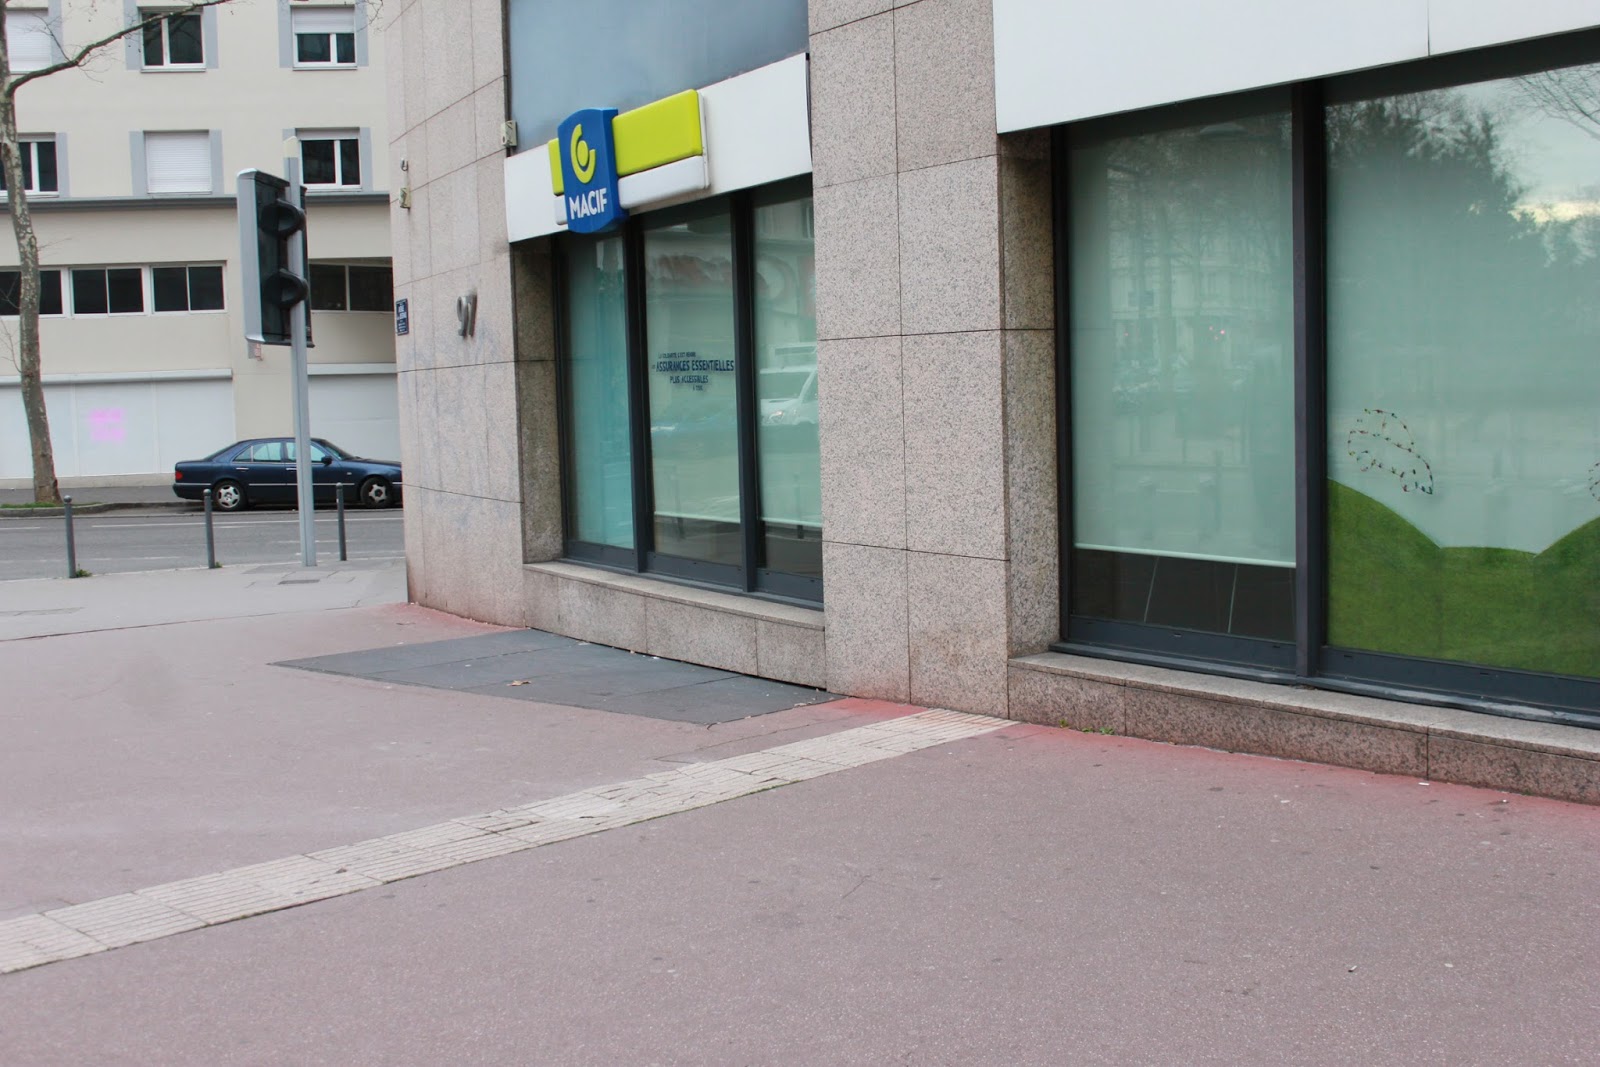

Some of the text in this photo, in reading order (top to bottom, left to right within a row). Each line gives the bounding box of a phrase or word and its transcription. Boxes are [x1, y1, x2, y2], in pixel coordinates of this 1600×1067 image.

[569, 188, 607, 220] MACIF
[456, 294, 477, 337] 97
[656, 360, 690, 372] ASSURANCES
[692, 359, 734, 371] ESSENTIELLES
[670, 375, 680, 384] PLUS
